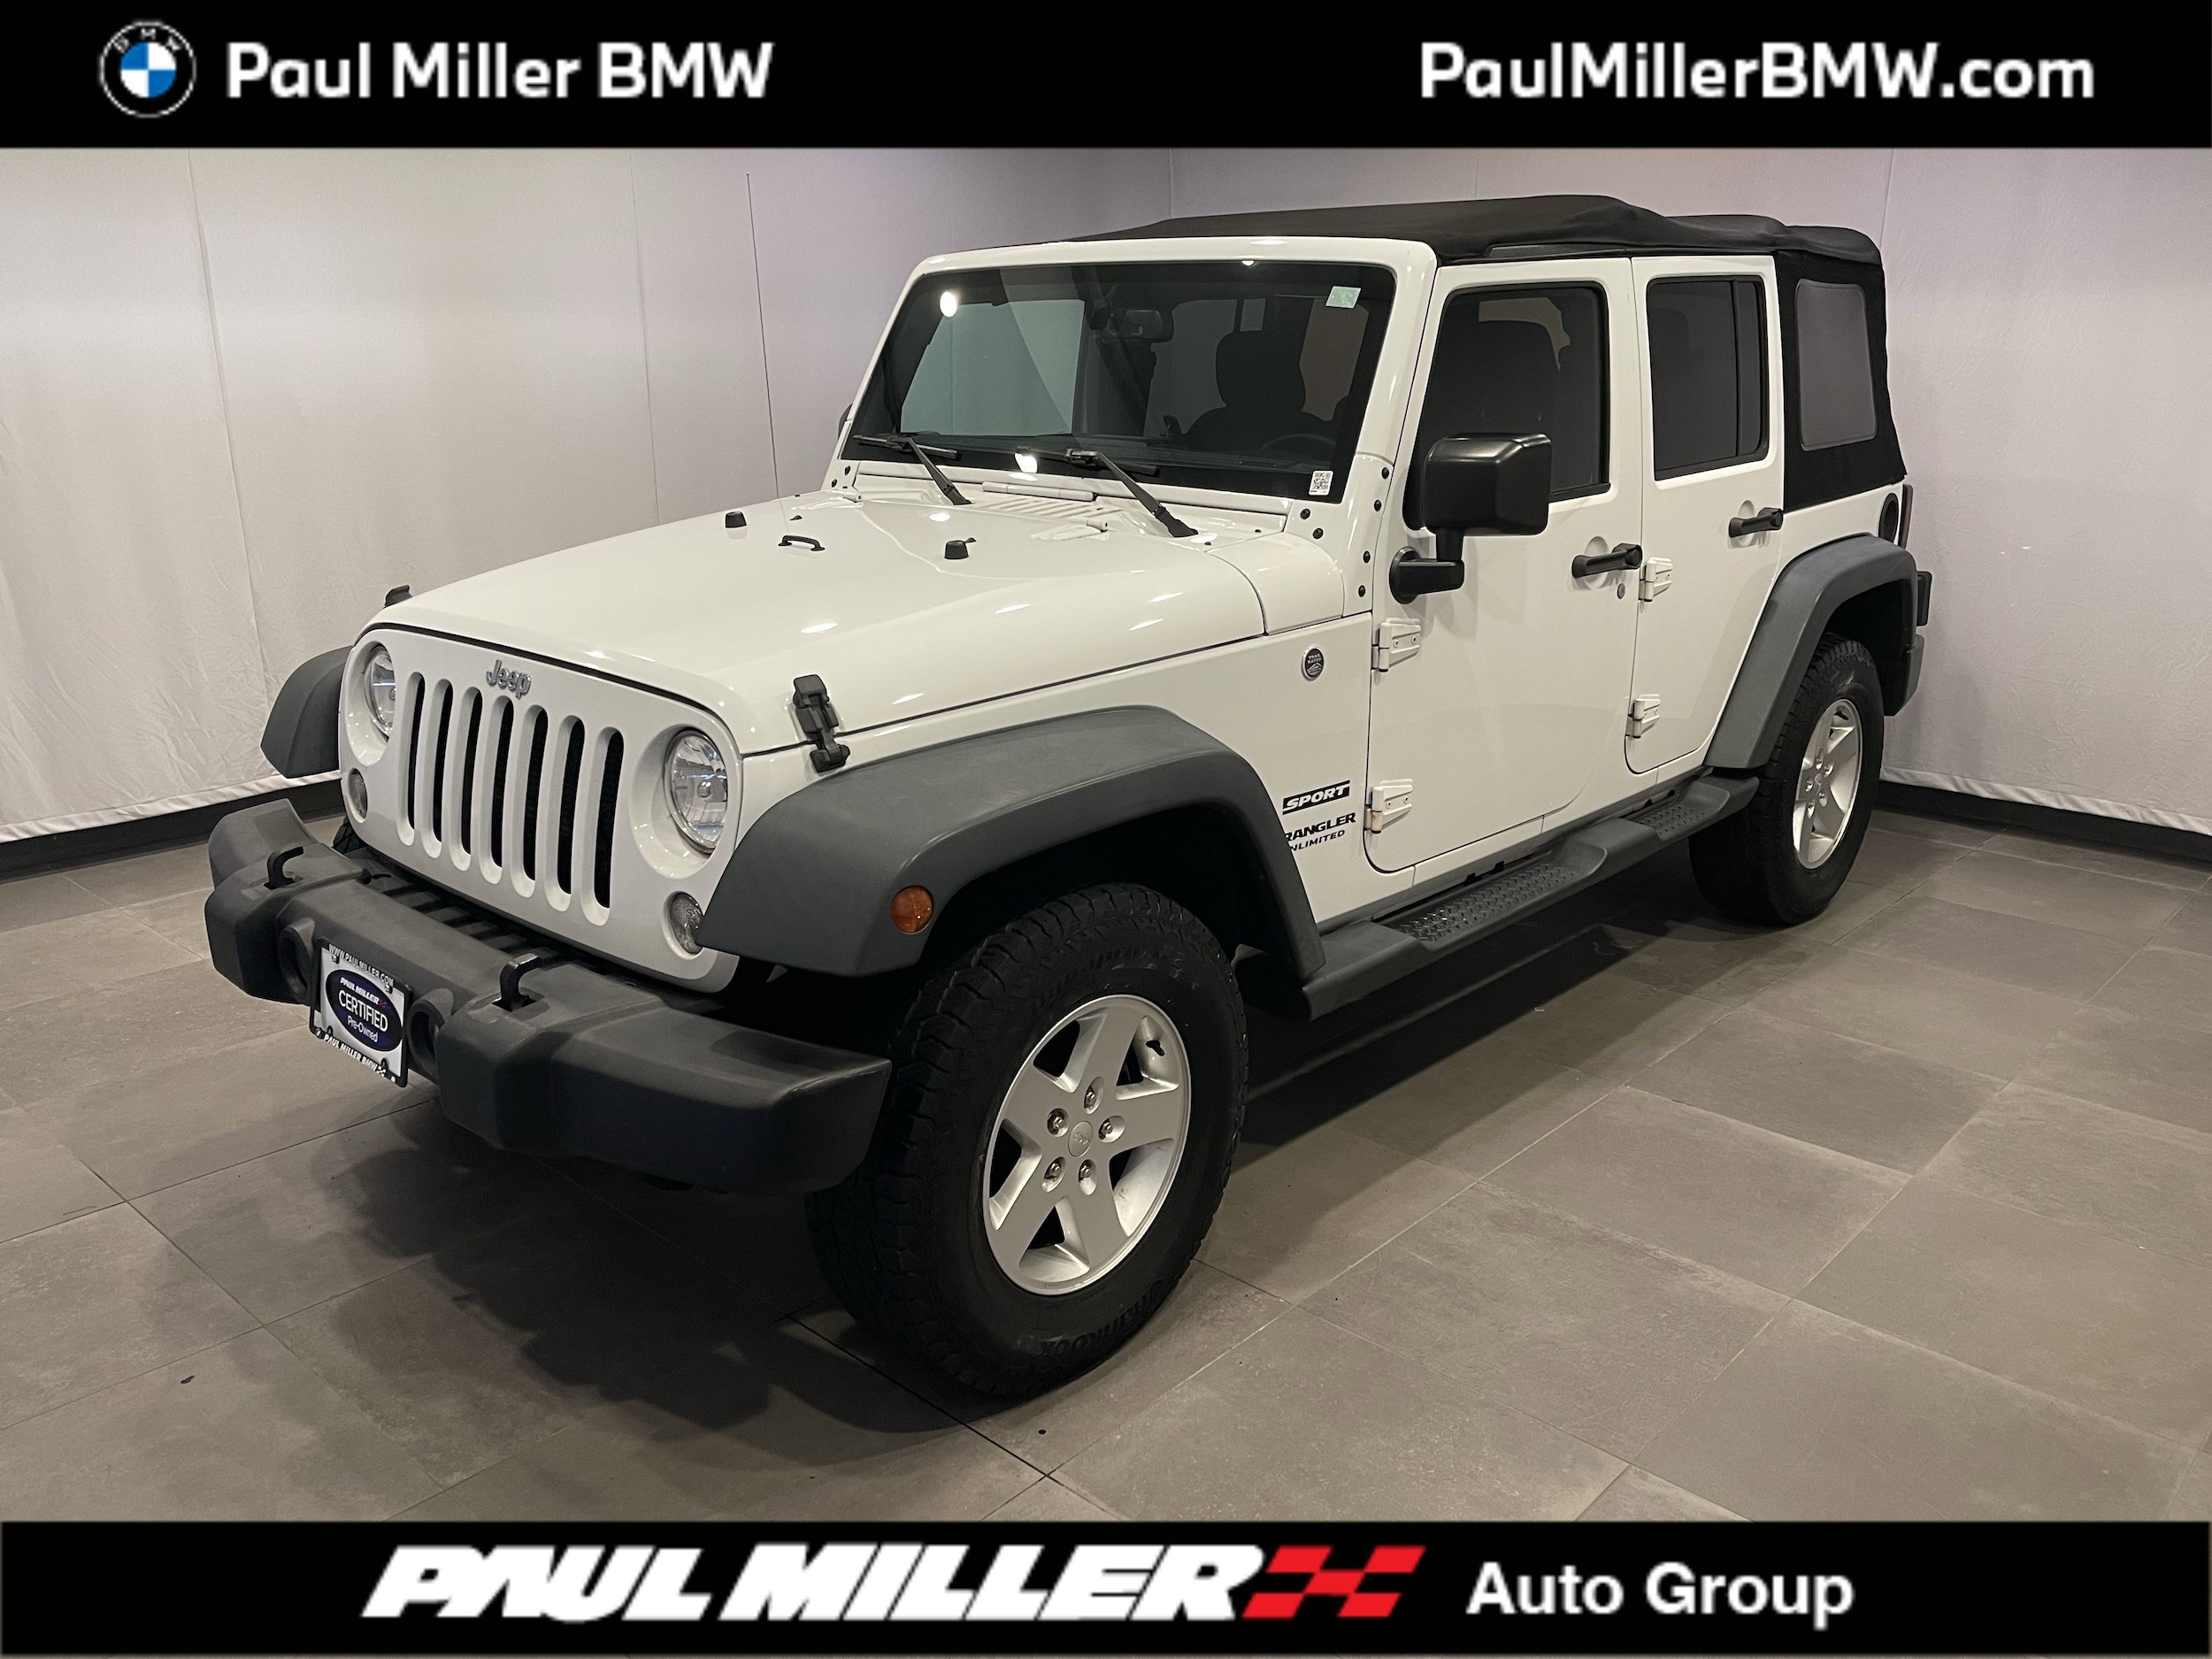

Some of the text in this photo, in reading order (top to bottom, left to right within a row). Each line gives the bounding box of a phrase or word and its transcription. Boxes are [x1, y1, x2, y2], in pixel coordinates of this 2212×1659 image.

[486, 659, 532, 701] Jeep
[1283, 782, 1350, 811] SPORT
[1285, 812, 1356, 841] RANGLER
[1289, 830, 1345, 851] NLIMITED
[355, 985, 380, 1005] MILLER
[338, 989, 388, 1033] CERTIFIED
[348, 1015, 378, 1042] Pre-Owned
[324, 1033, 379, 1071] PAUL MILLER BMW
